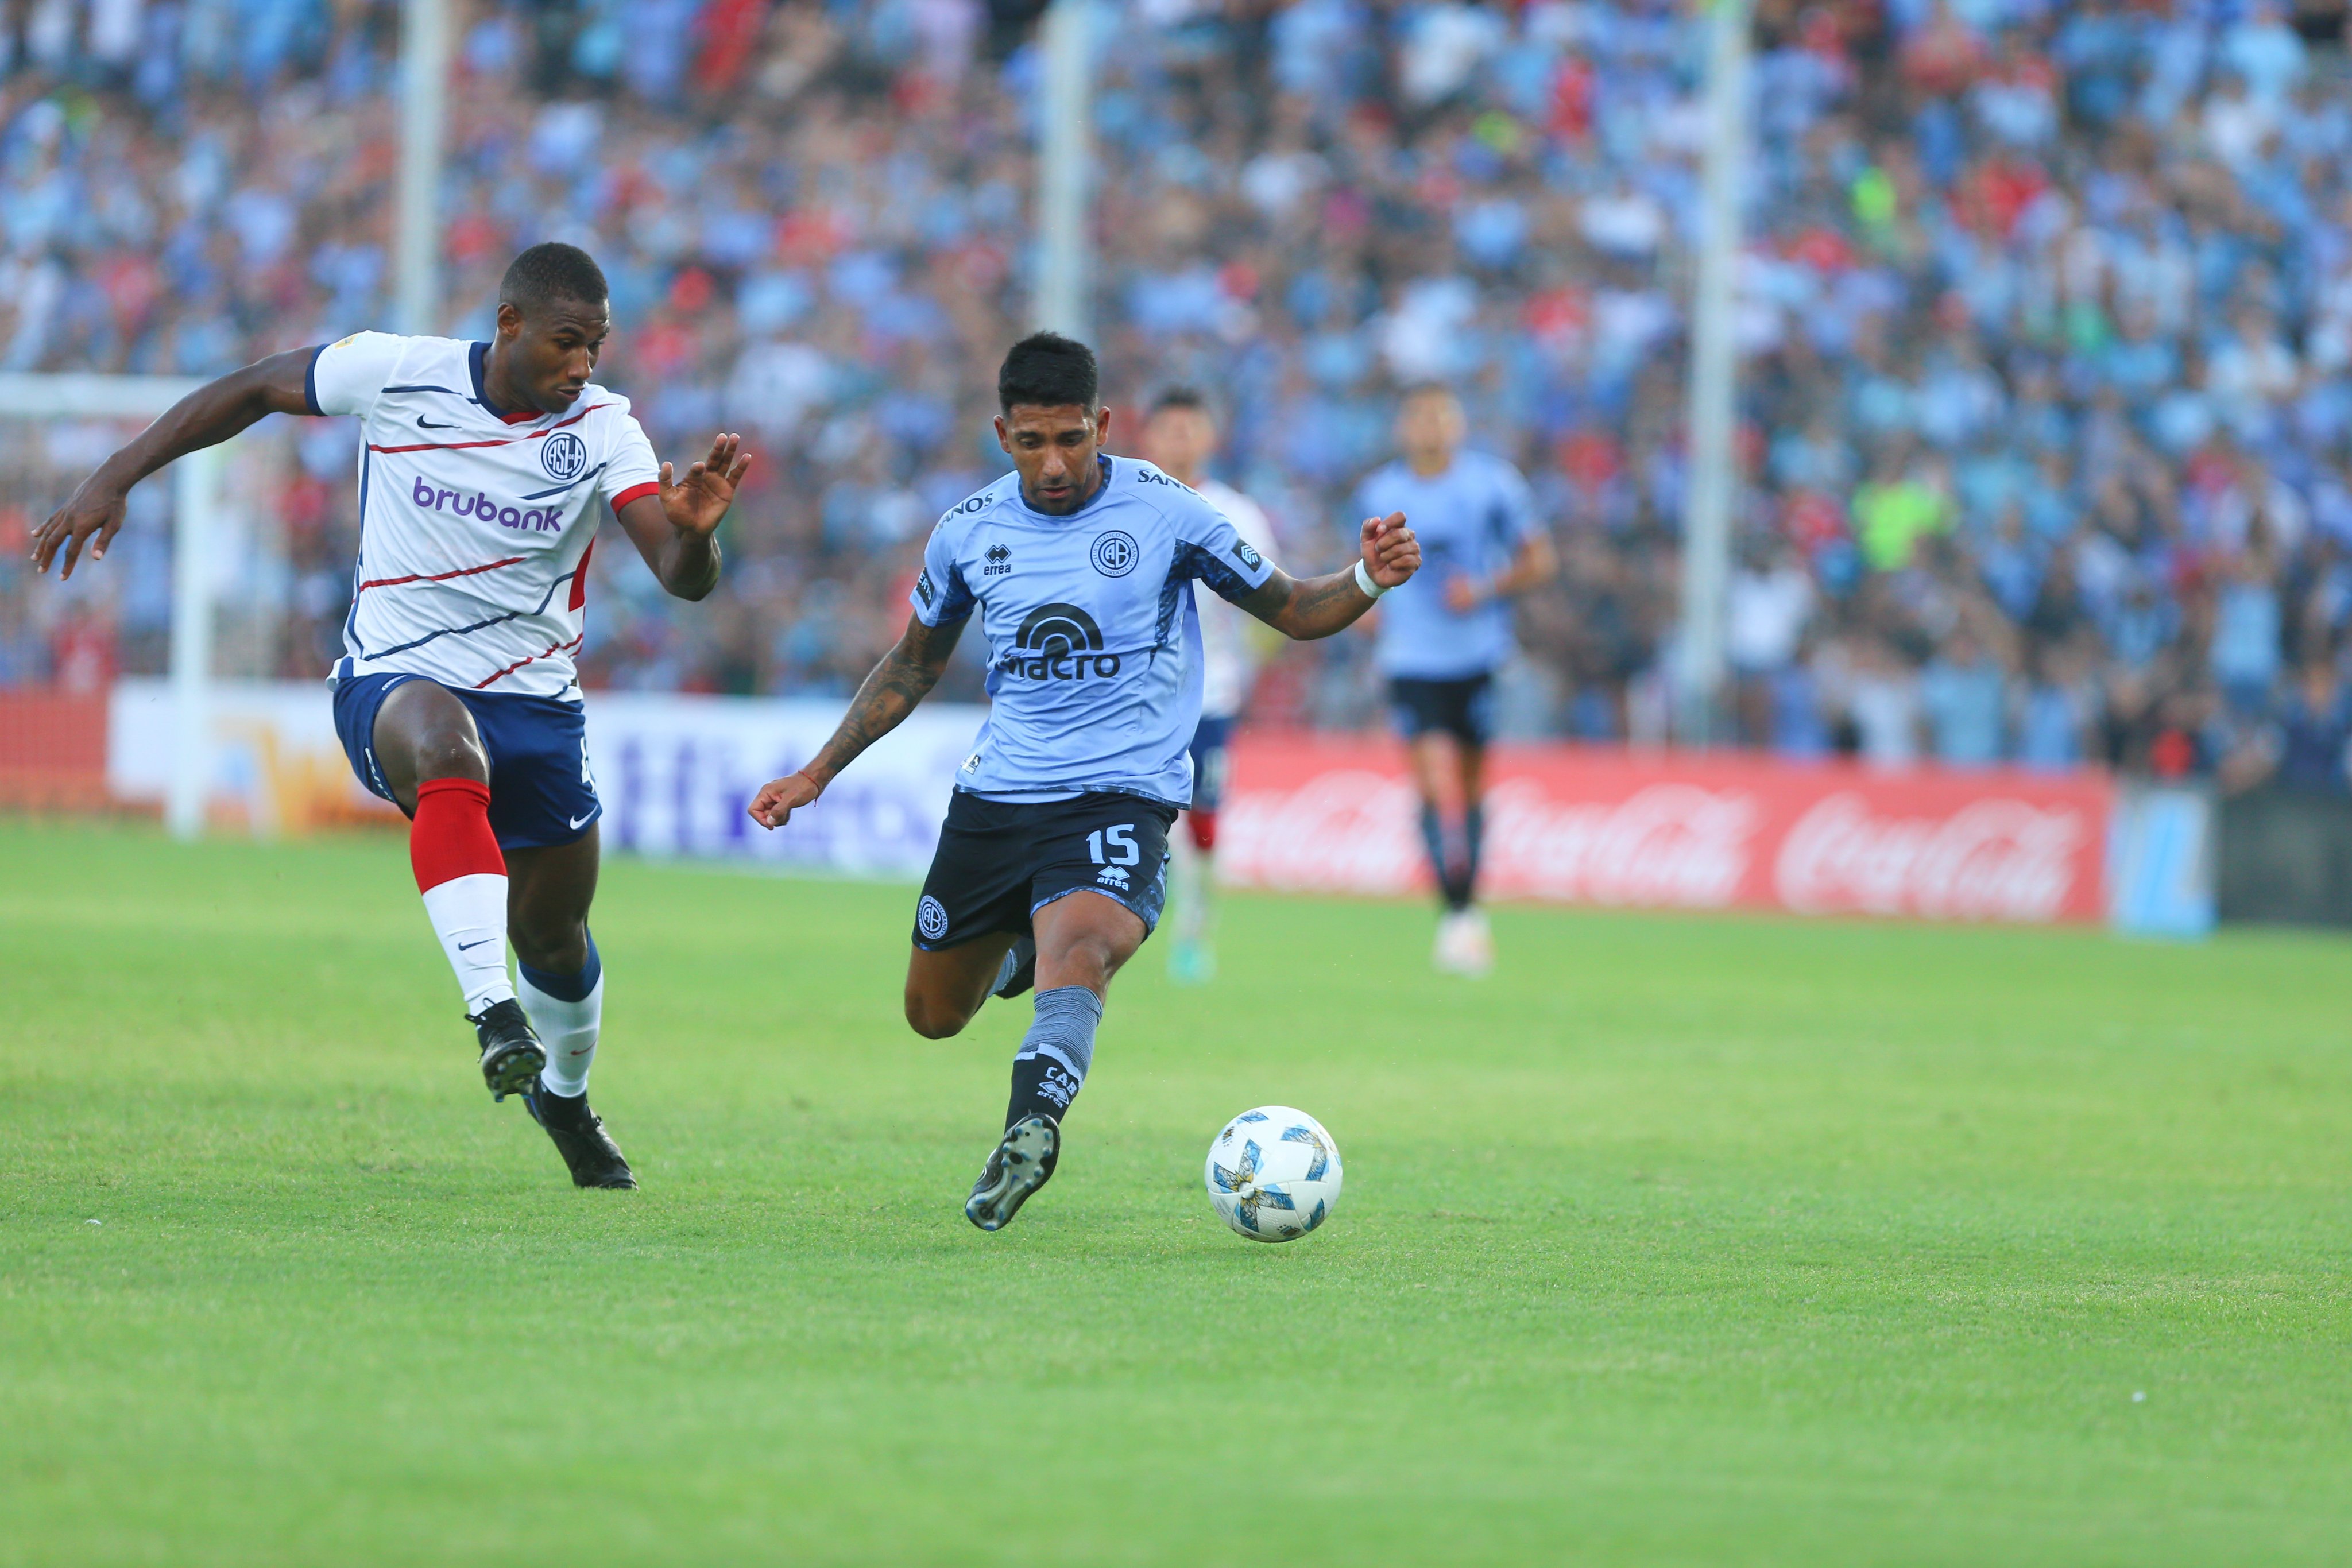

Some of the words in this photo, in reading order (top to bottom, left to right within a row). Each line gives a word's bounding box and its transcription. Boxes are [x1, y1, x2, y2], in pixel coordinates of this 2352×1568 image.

[413, 475, 563, 532] brubank
[1086, 823, 1139, 866] 15
[1045, 1066, 1077, 1095] CAB
